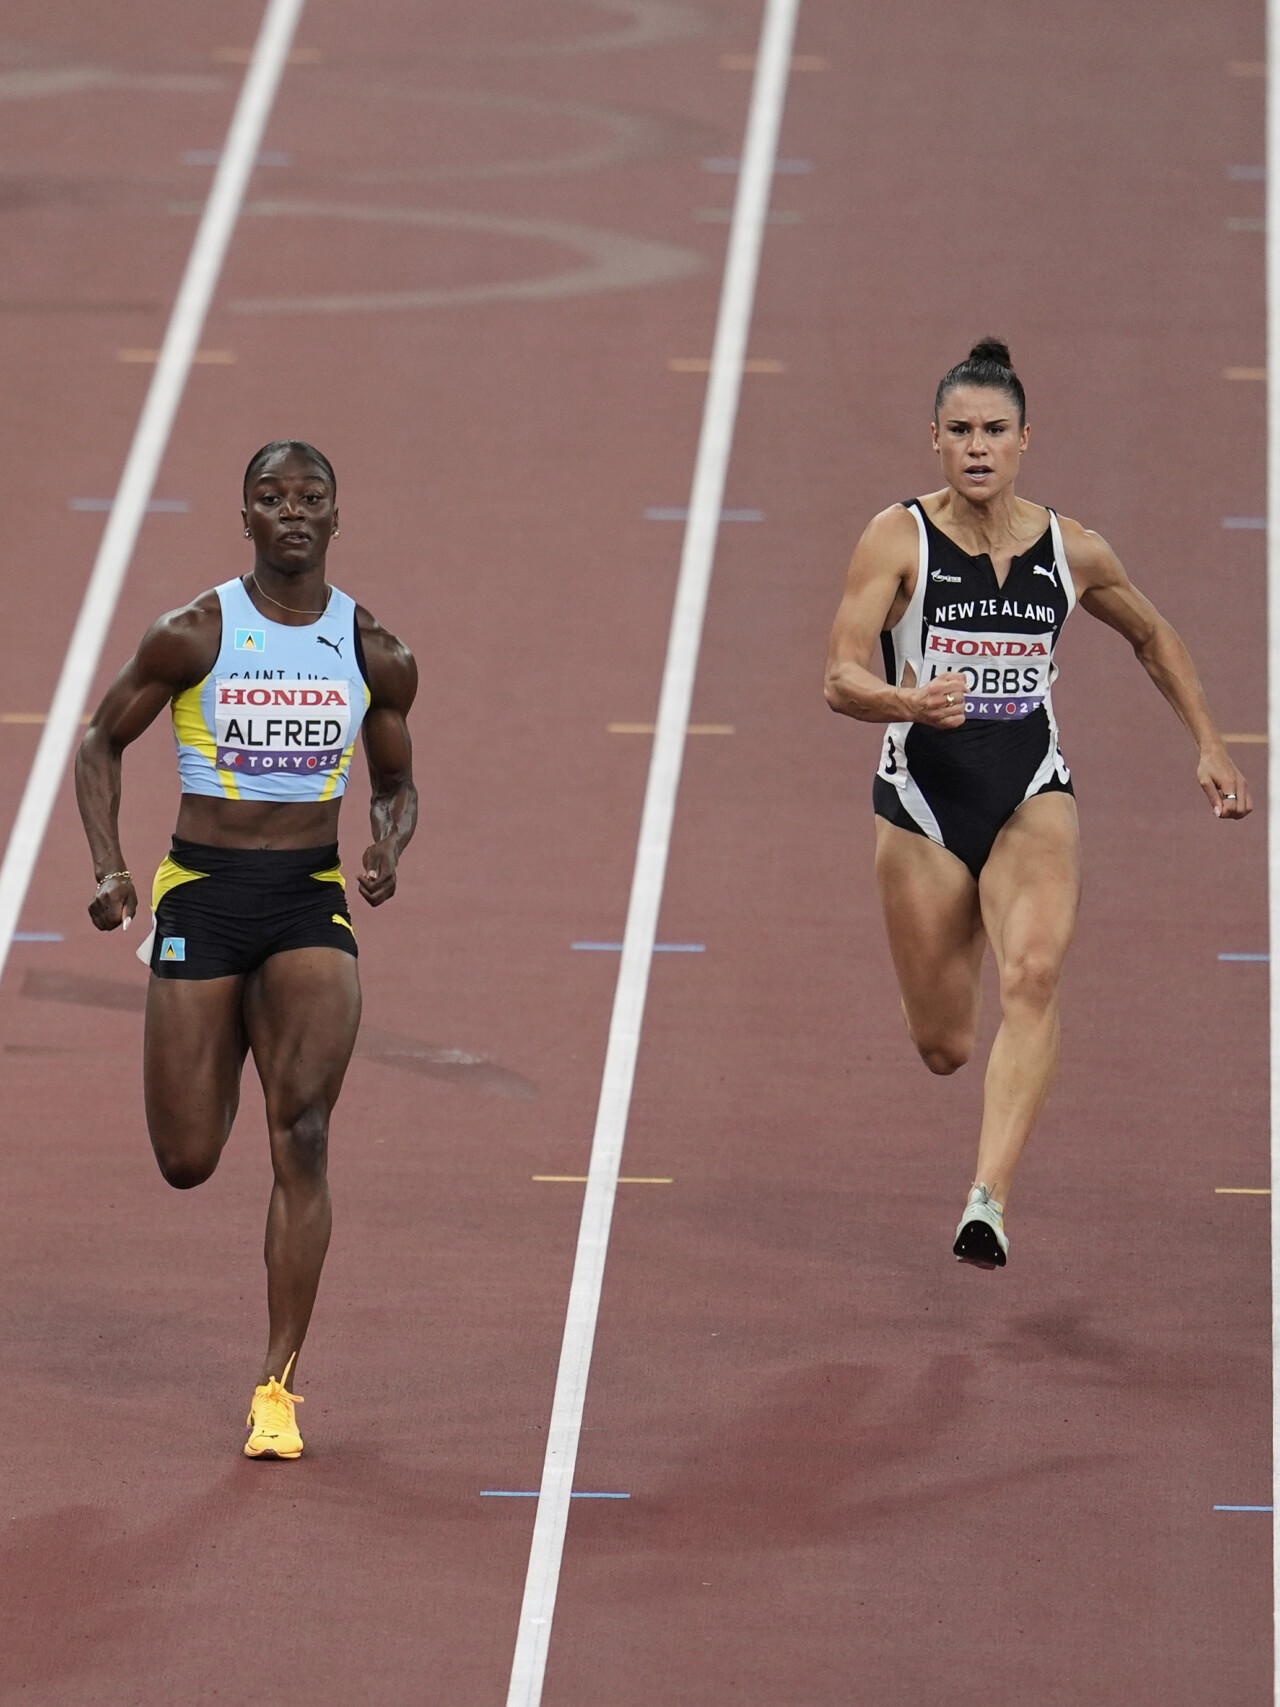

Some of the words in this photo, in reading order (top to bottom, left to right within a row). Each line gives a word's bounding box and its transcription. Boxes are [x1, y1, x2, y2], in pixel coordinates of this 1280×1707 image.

[935, 601, 975, 623] NEW
[929, 634, 1048, 657] HONDA
[219, 688, 347, 706] HONDA
[224, 719, 341, 747] ALFRED
[884, 735, 898, 775] 3
